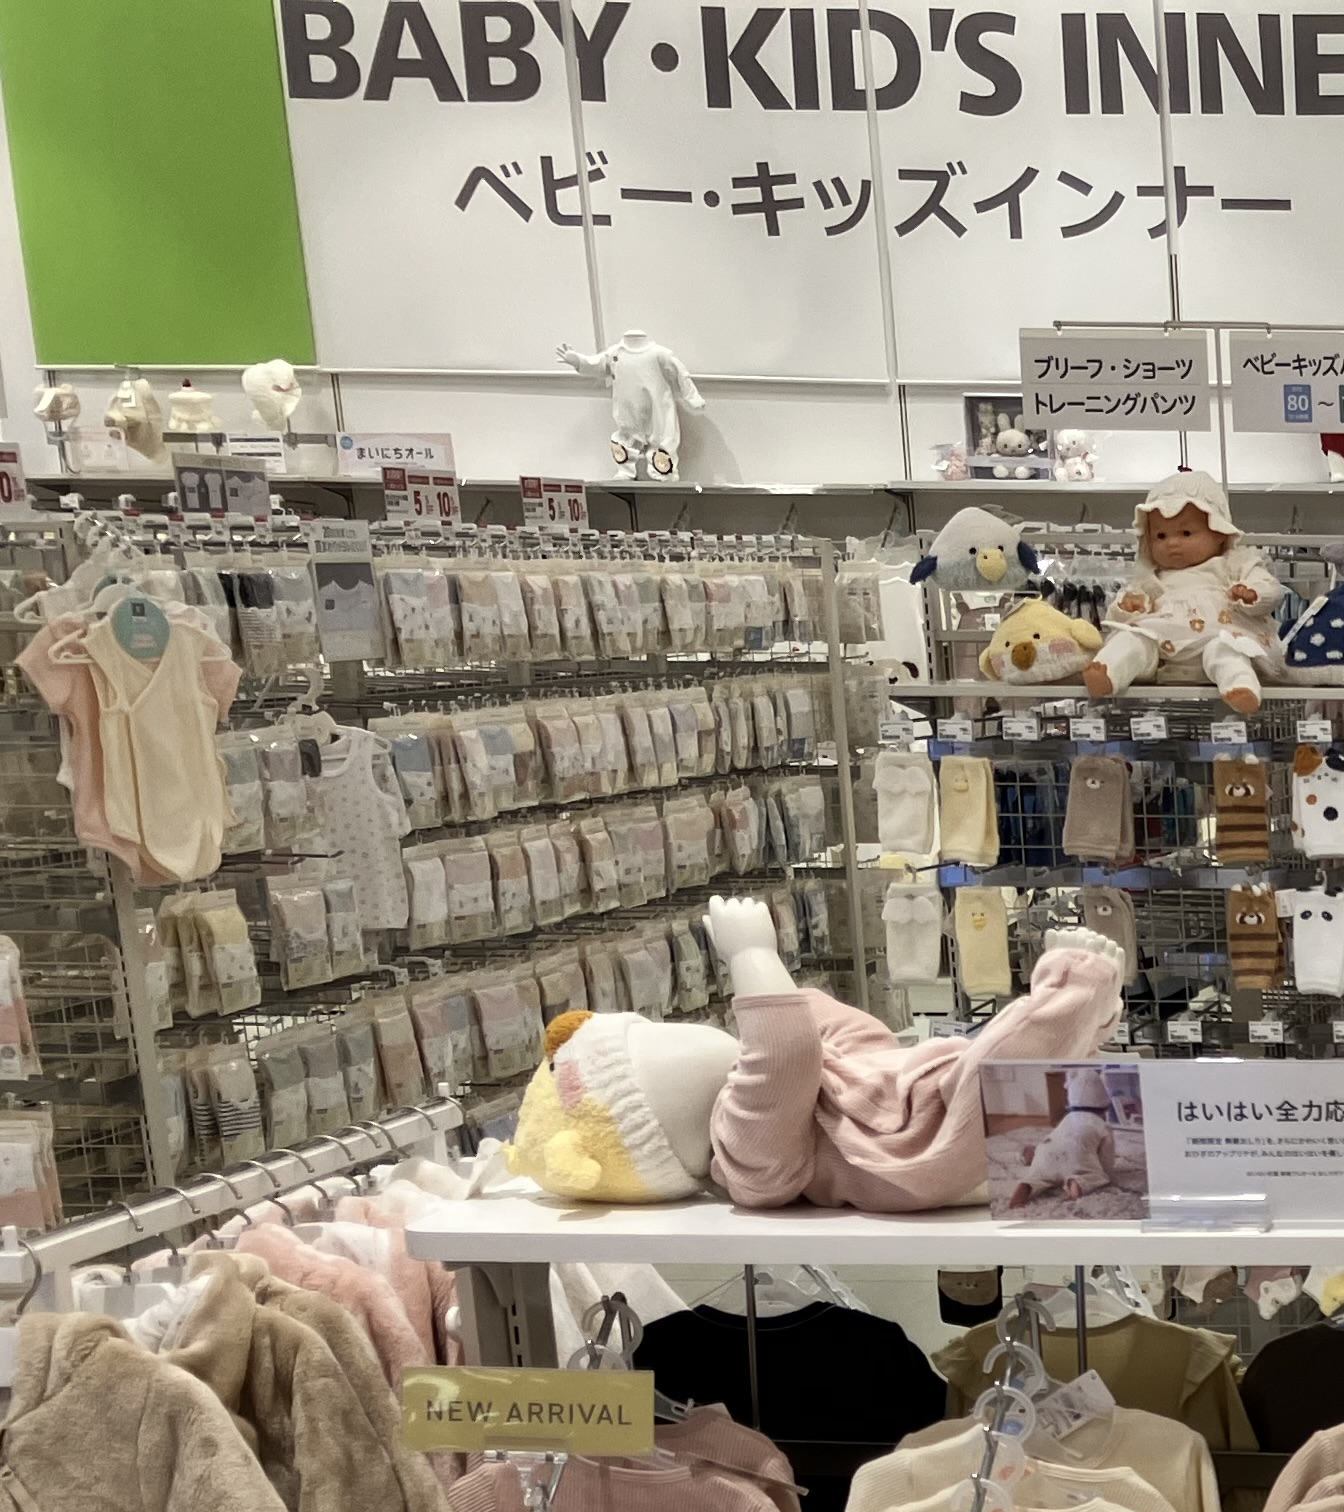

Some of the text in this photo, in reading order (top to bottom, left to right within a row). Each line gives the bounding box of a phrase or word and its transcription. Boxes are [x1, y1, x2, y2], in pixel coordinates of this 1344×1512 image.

[454, 151, 1292, 240] ベビー・キッズインナー
[1034, 356, 1193, 380] ブリーフ・ショーツ
[1035, 392, 1196, 416] トレーニングパンツ
[1287, 395, 1309, 411] 80
[356, 447, 435, 460] まいにちオール
[426, 1400, 633, 1426] NEW ARRIVAL
